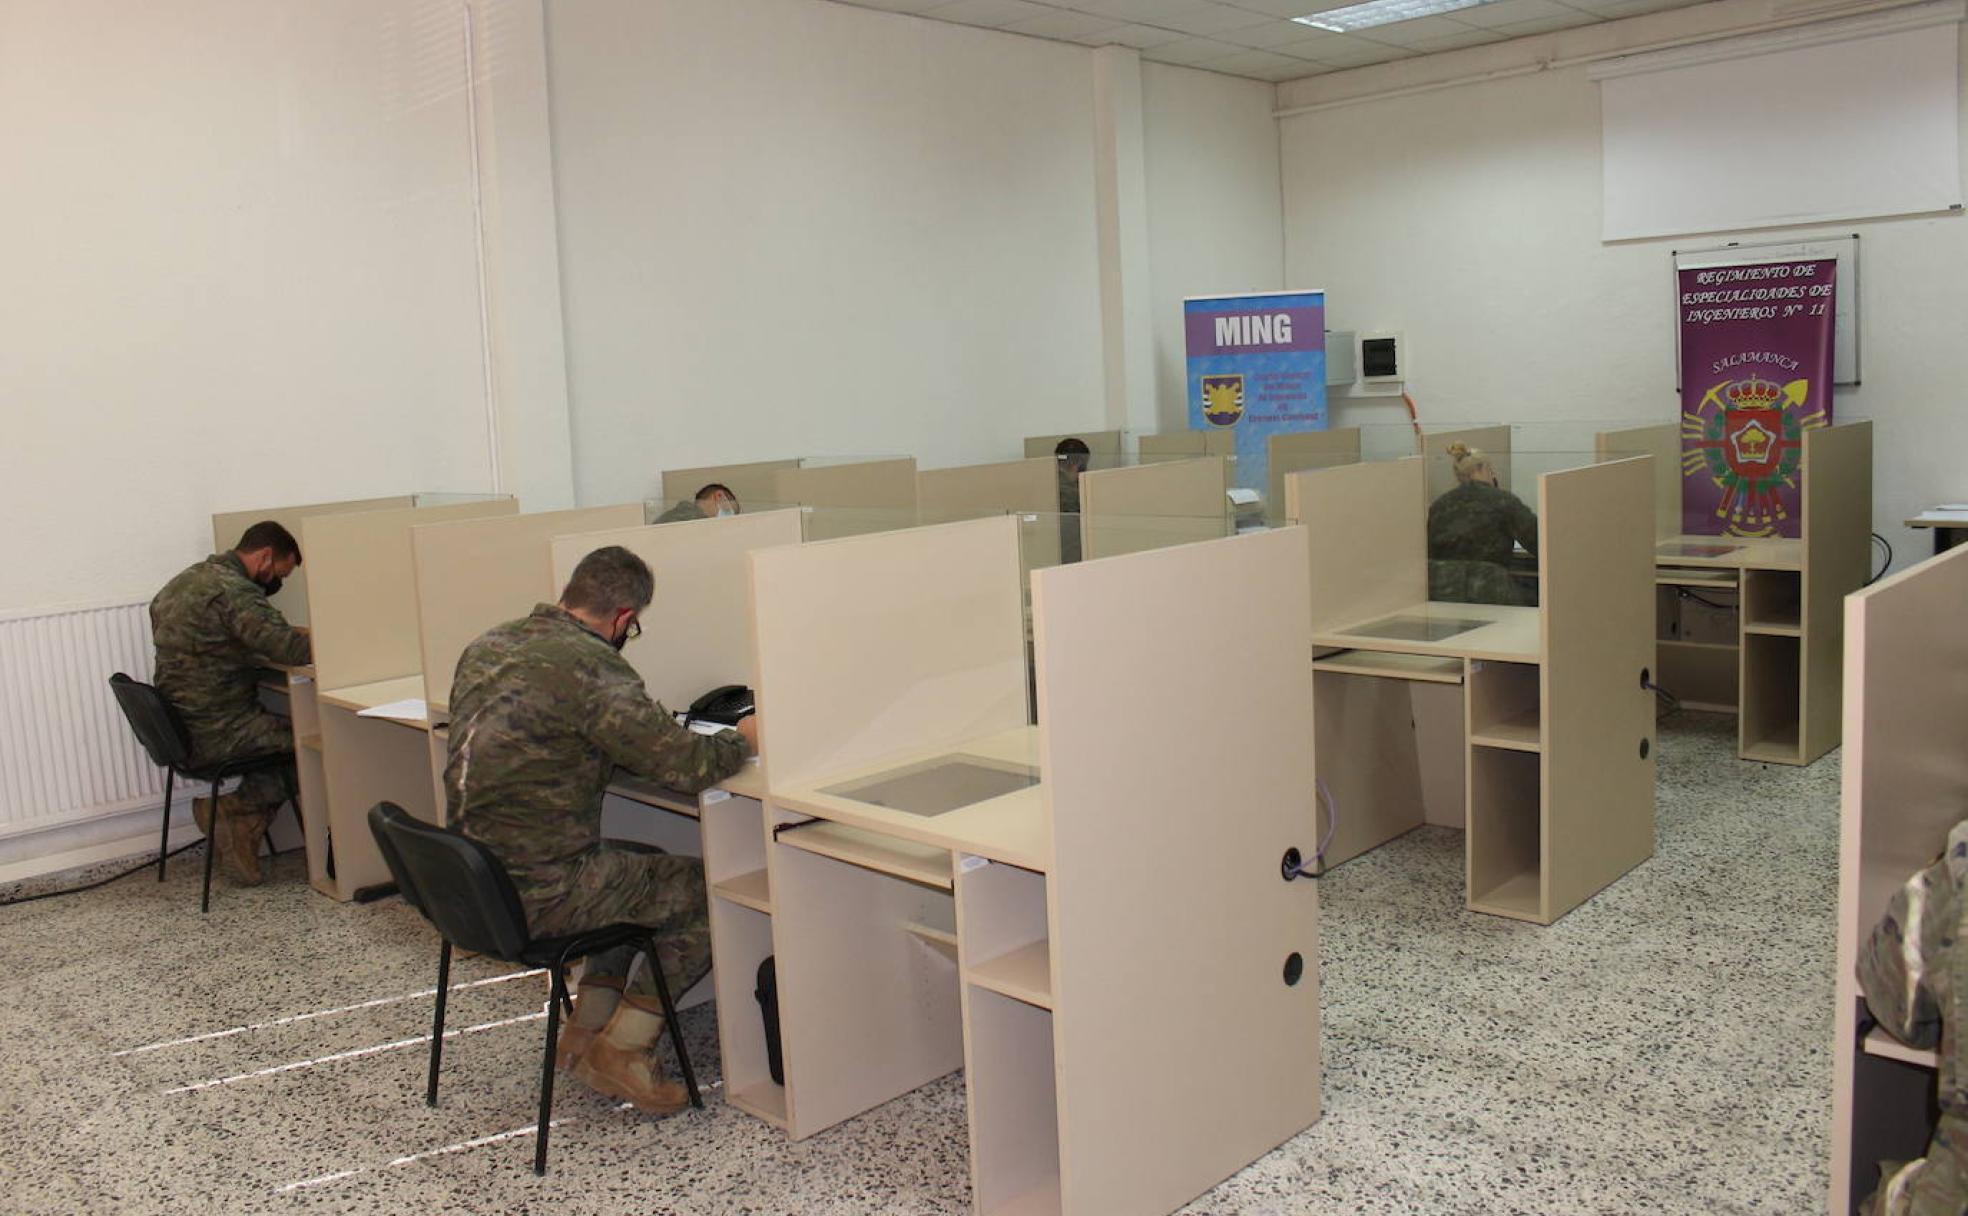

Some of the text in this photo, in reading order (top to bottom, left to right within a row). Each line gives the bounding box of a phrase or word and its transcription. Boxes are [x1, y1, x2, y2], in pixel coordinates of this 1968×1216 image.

[1696, 265, 1816, 285] REGIMIENTO DE
[1682, 284, 1833, 304] ESPECIALIDADES DE
[1686, 306, 1777, 324] INGENIEROS
[1809, 304, 1825, 316] 11
[1215, 313, 1293, 347] MING
[1712, 352, 1799, 374] SALAMANCA
